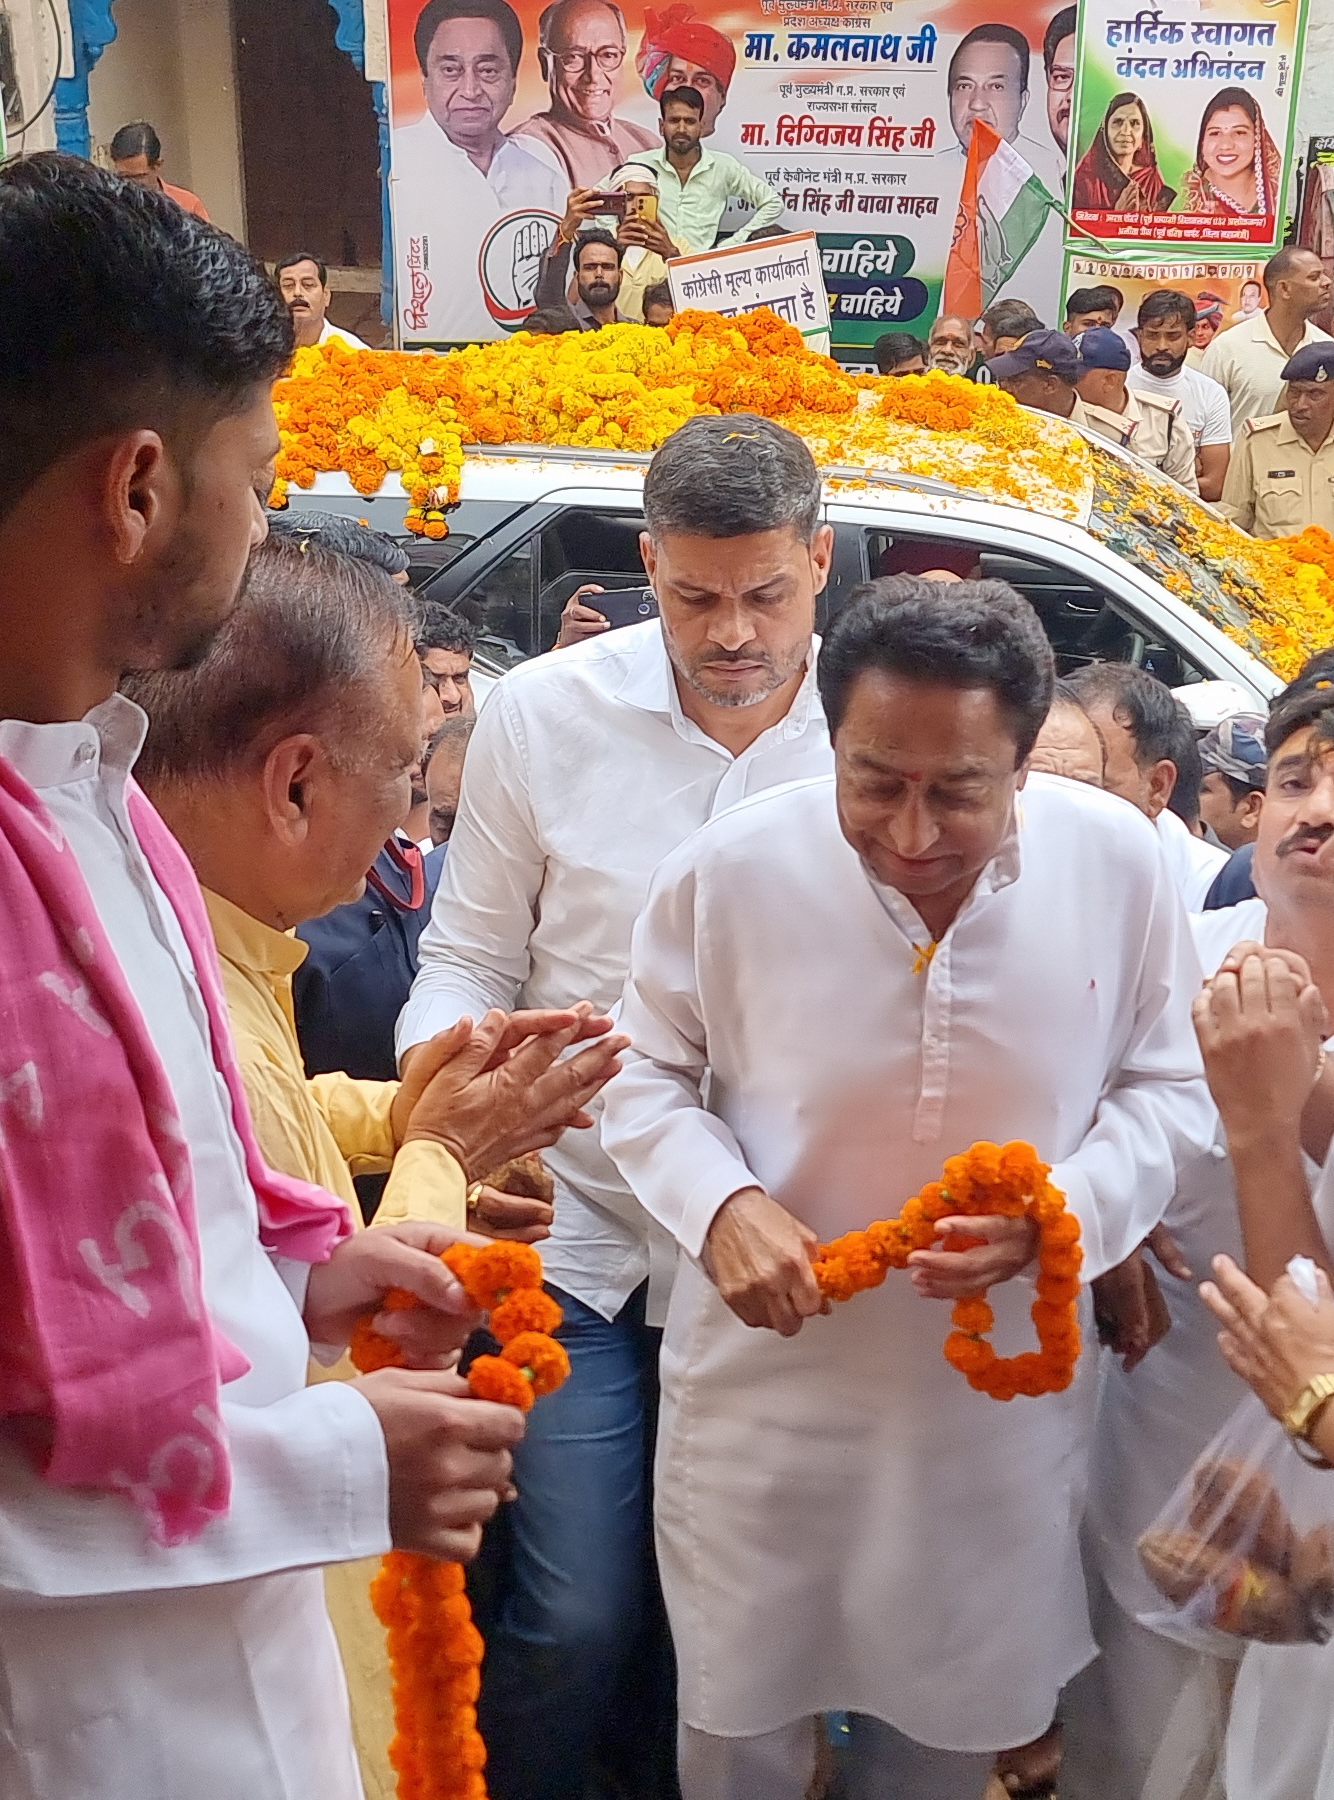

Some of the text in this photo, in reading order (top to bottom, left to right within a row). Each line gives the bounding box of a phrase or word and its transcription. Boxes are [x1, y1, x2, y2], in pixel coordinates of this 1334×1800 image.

[745, 23, 937, 63] मा. कमलनाथ जी
[1106, 10, 1276, 47] हार्दिक स्वागत
[1116, 47, 1167, 78] वंदन
[1171, 51, 1266, 80] अभिनंदन
[779, 81, 792, 98] पूर्व
[795, 81, 833, 98] मुख्यमंत्री
[859, 86, 890, 97] सरकार
[892, 83, 906, 99] एवं
[807, 99, 877, 113] राज्यसभा सांसद
[741, 115, 936, 152] मा. दिग्विजय सिंह जी
[765, 168, 782, 187] पूर्व
[823, 168, 842, 184] मंत्री
[845, 172, 868, 185] म.प्र.
[871, 173, 907, 186] सरकार
[802, 188, 832, 216] सिंह
[834, 189, 854, 213] जी
[822, 239, 899, 278] चाहिये
[404, 269, 432, 330] विशाल
[681, 269, 723, 300] कांग्रेसी
[725, 268, 752, 297] मूल्य
[800, 282, 816, 320] है
[840, 287, 904, 319] चाहिये
